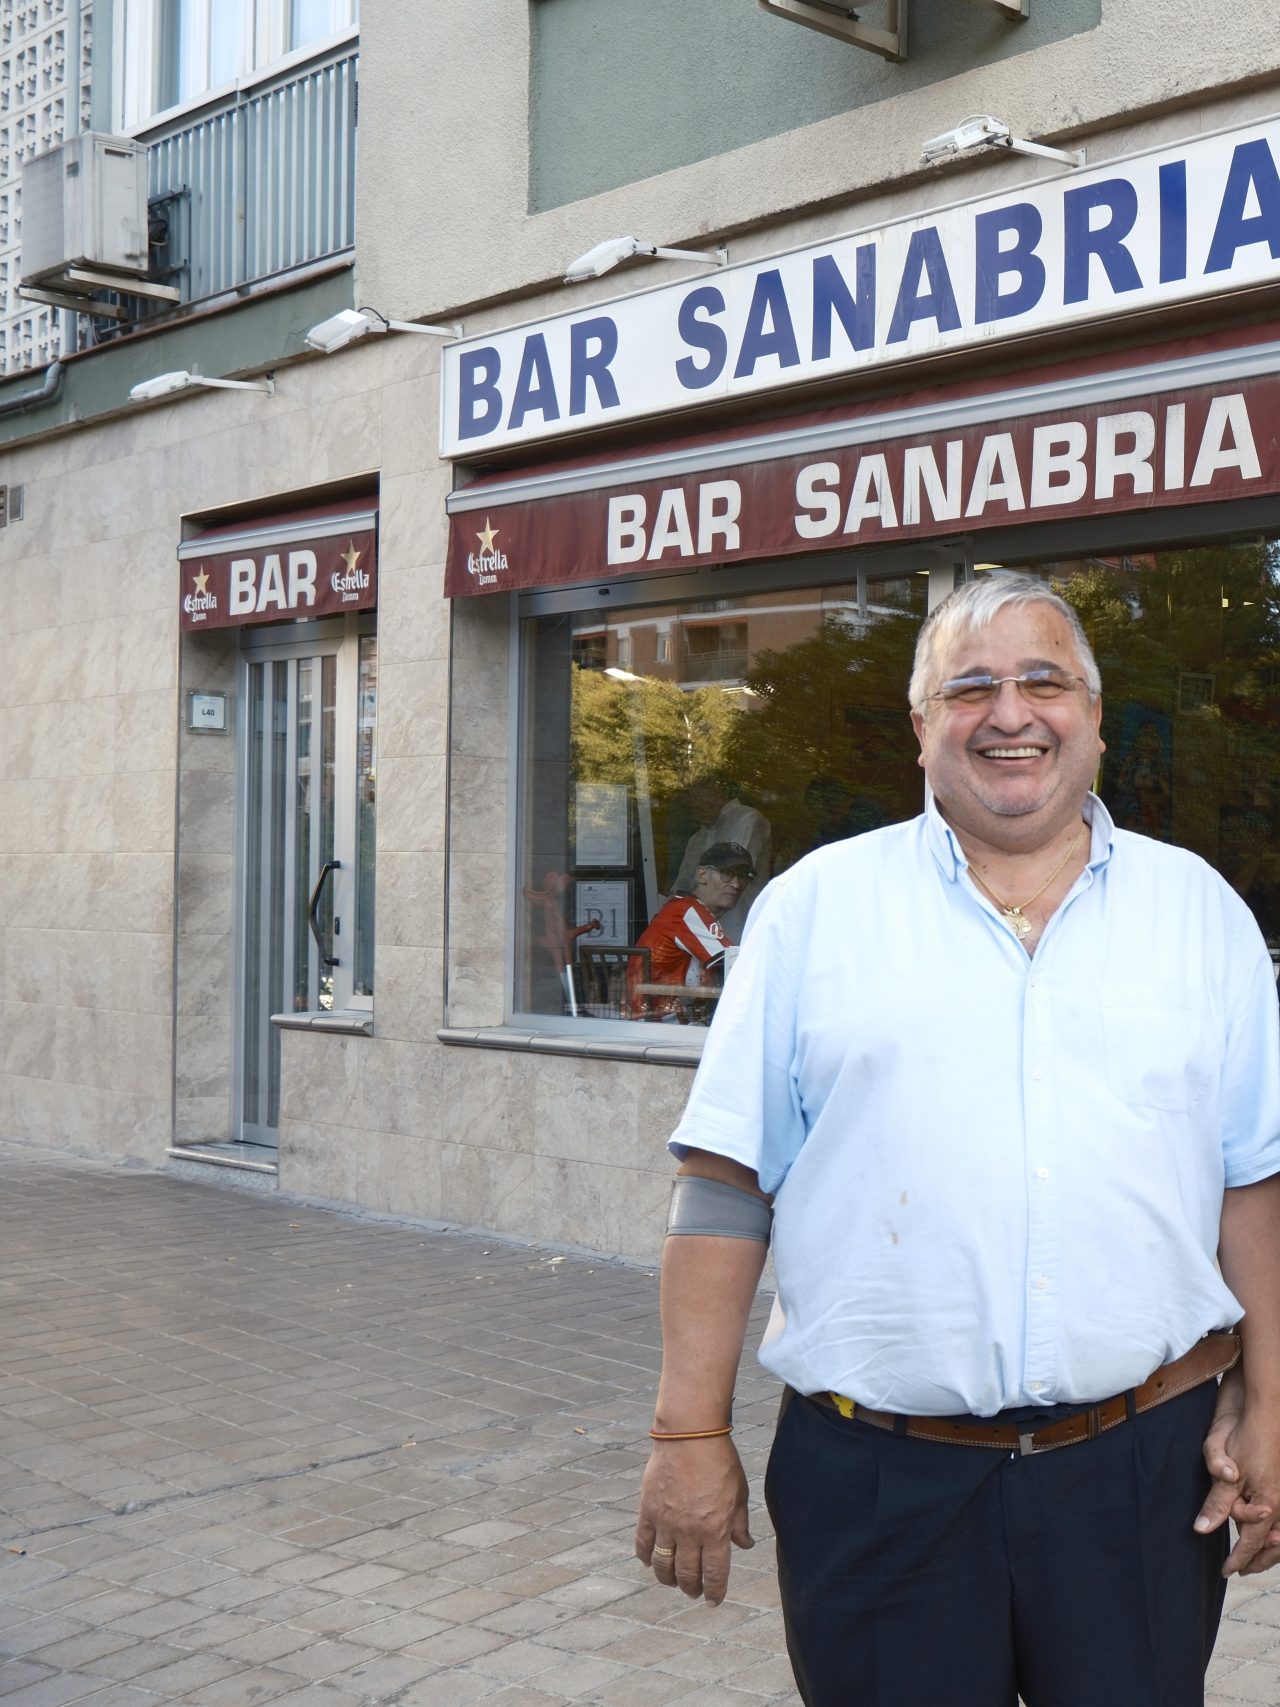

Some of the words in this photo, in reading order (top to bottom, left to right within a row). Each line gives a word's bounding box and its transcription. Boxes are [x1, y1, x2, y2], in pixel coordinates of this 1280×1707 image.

[457, 316, 620, 441] BAR
[607, 480, 742, 565] BAR
[795, 393, 1262, 540] SANABRIA
[229, 550, 318, 616] BAR
[331, 569, 369, 593] Estrella
[468, 549, 508, 575] Estrella
[184, 592, 217, 613] Estrella
